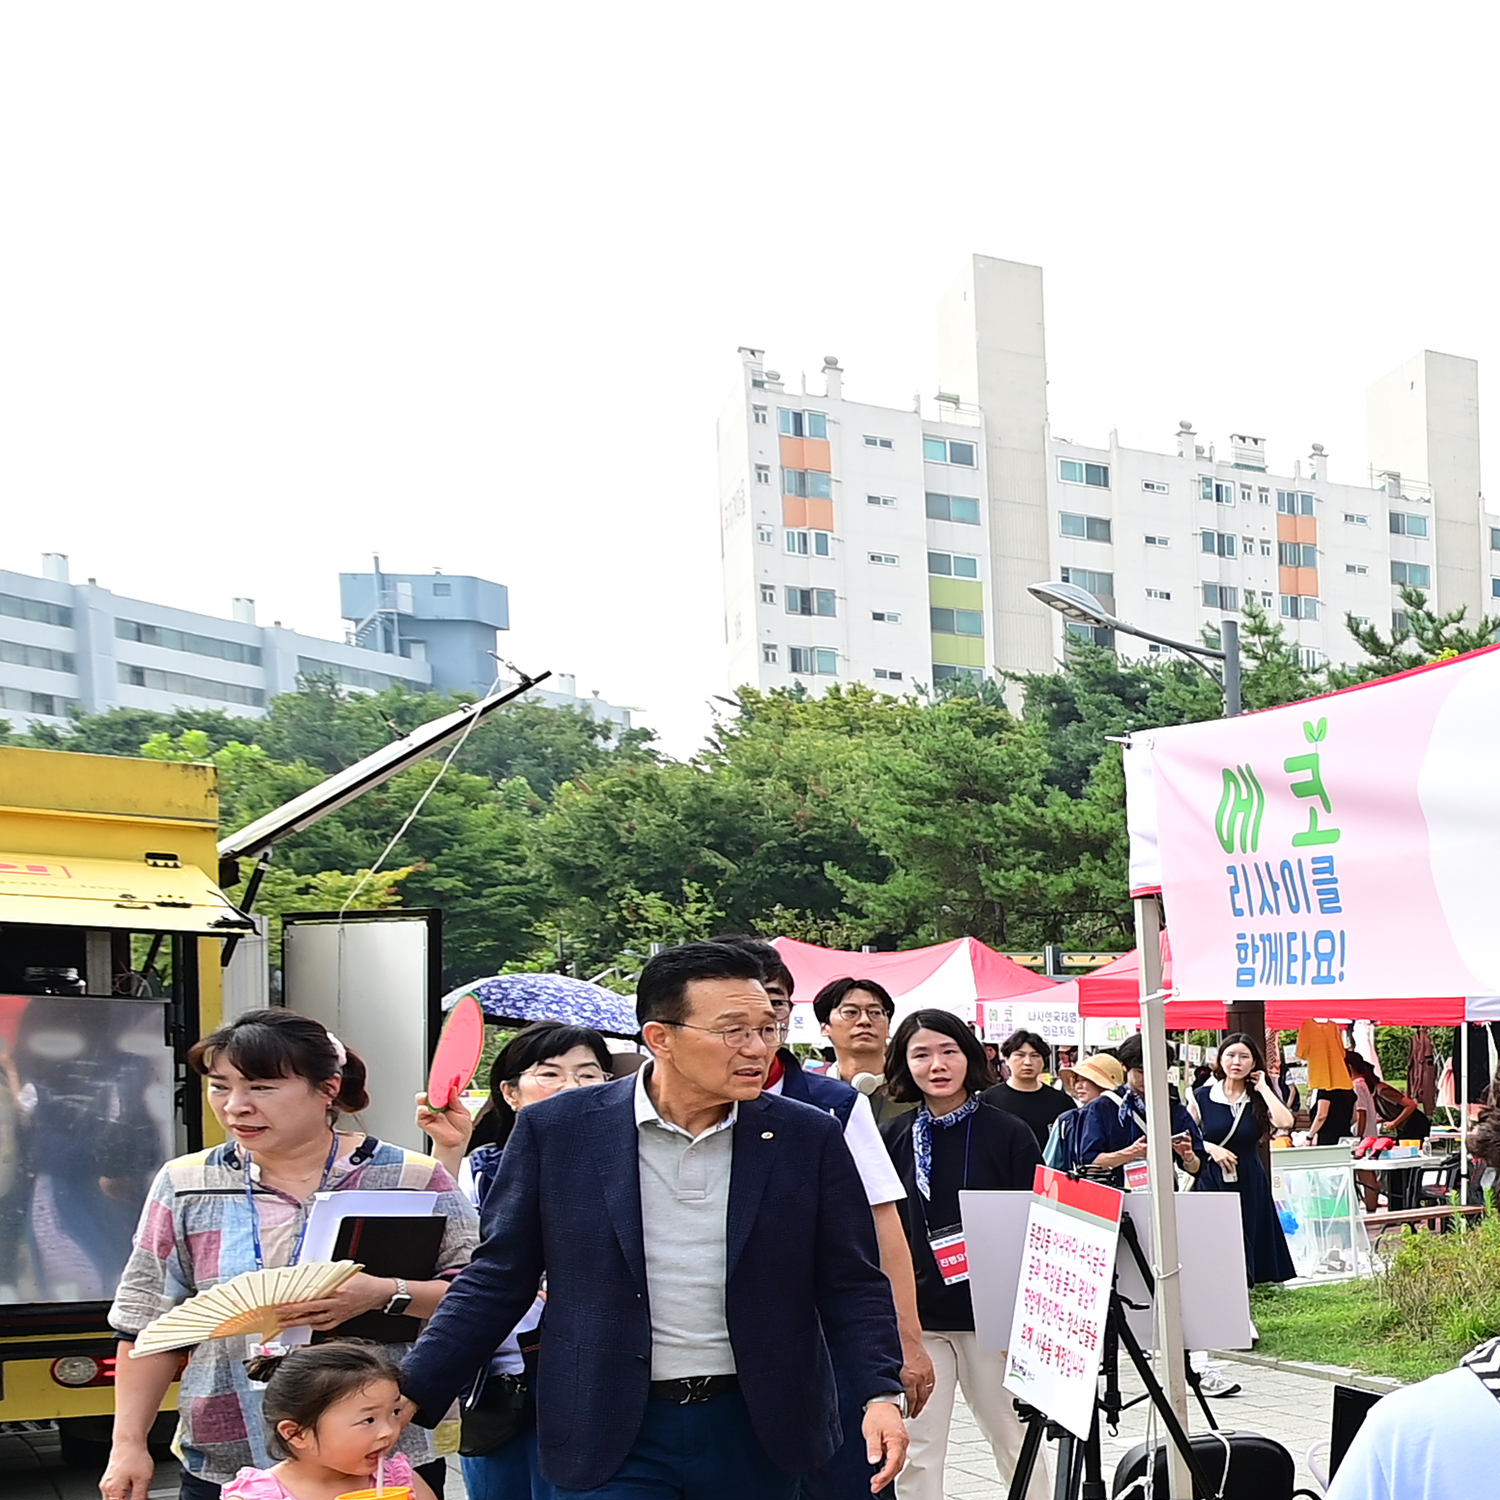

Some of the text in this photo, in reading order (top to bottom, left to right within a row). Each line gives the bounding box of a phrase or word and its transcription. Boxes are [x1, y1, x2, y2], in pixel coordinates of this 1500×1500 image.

[1215, 750, 1340, 854] 에코
[1226, 855, 1343, 918] 리사이클
[1235, 929, 1346, 988] 함께타요!
[939, 1252, 968, 1268] 진행요
[1054, 1343, 1086, 1380] 예정입니다
